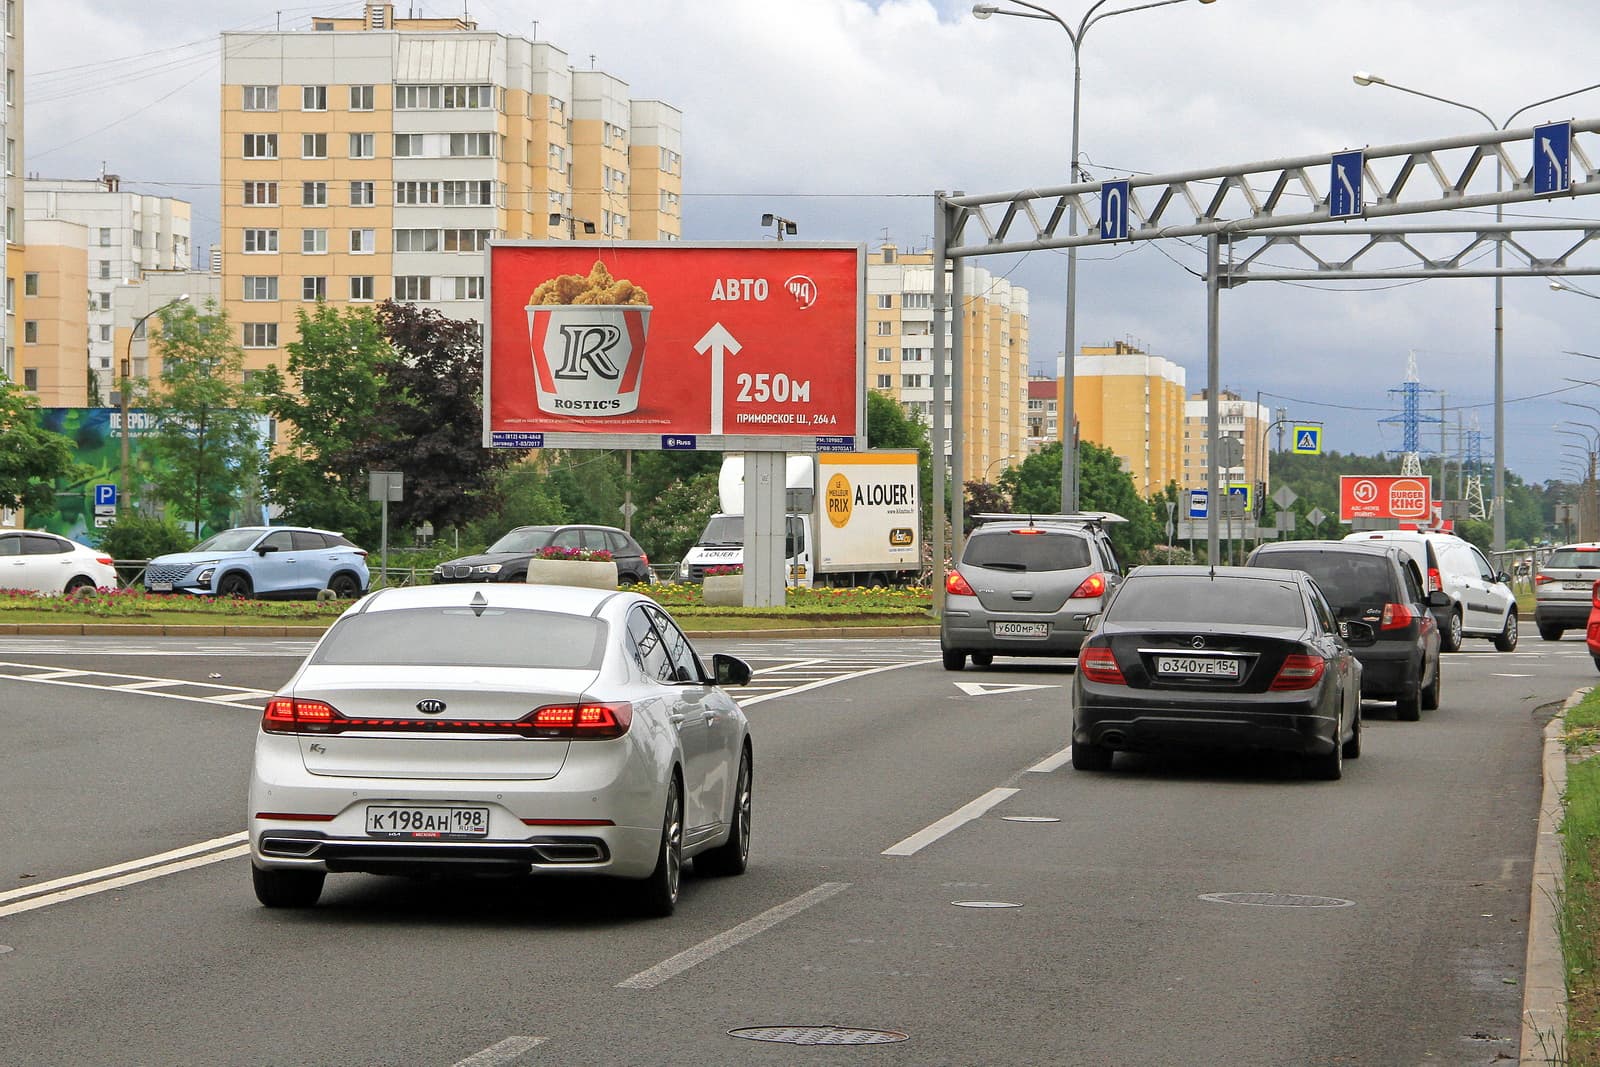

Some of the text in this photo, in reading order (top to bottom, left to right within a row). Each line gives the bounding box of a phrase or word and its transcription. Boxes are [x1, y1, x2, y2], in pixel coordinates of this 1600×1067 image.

[711, 278, 769, 301] АВТО
[554, 399, 621, 409] ROSTIC'S
[736, 413, 795, 424] ПРИМОРСКОЕ
[813, 414, 829, 424] 264
[830, 414, 837, 424] А
[854, 484, 864, 506] A
[867, 484, 908, 506] LOUER
[1391, 491, 1424, 499] BURGER
[829, 498, 849, 512] PRIX
[1391, 499, 1424, 509] KING
[1162, 659, 1236, 673] О340УЕ 154
[420, 701, 441, 711] KIA
[373, 810, 482, 831] К198АН 198
